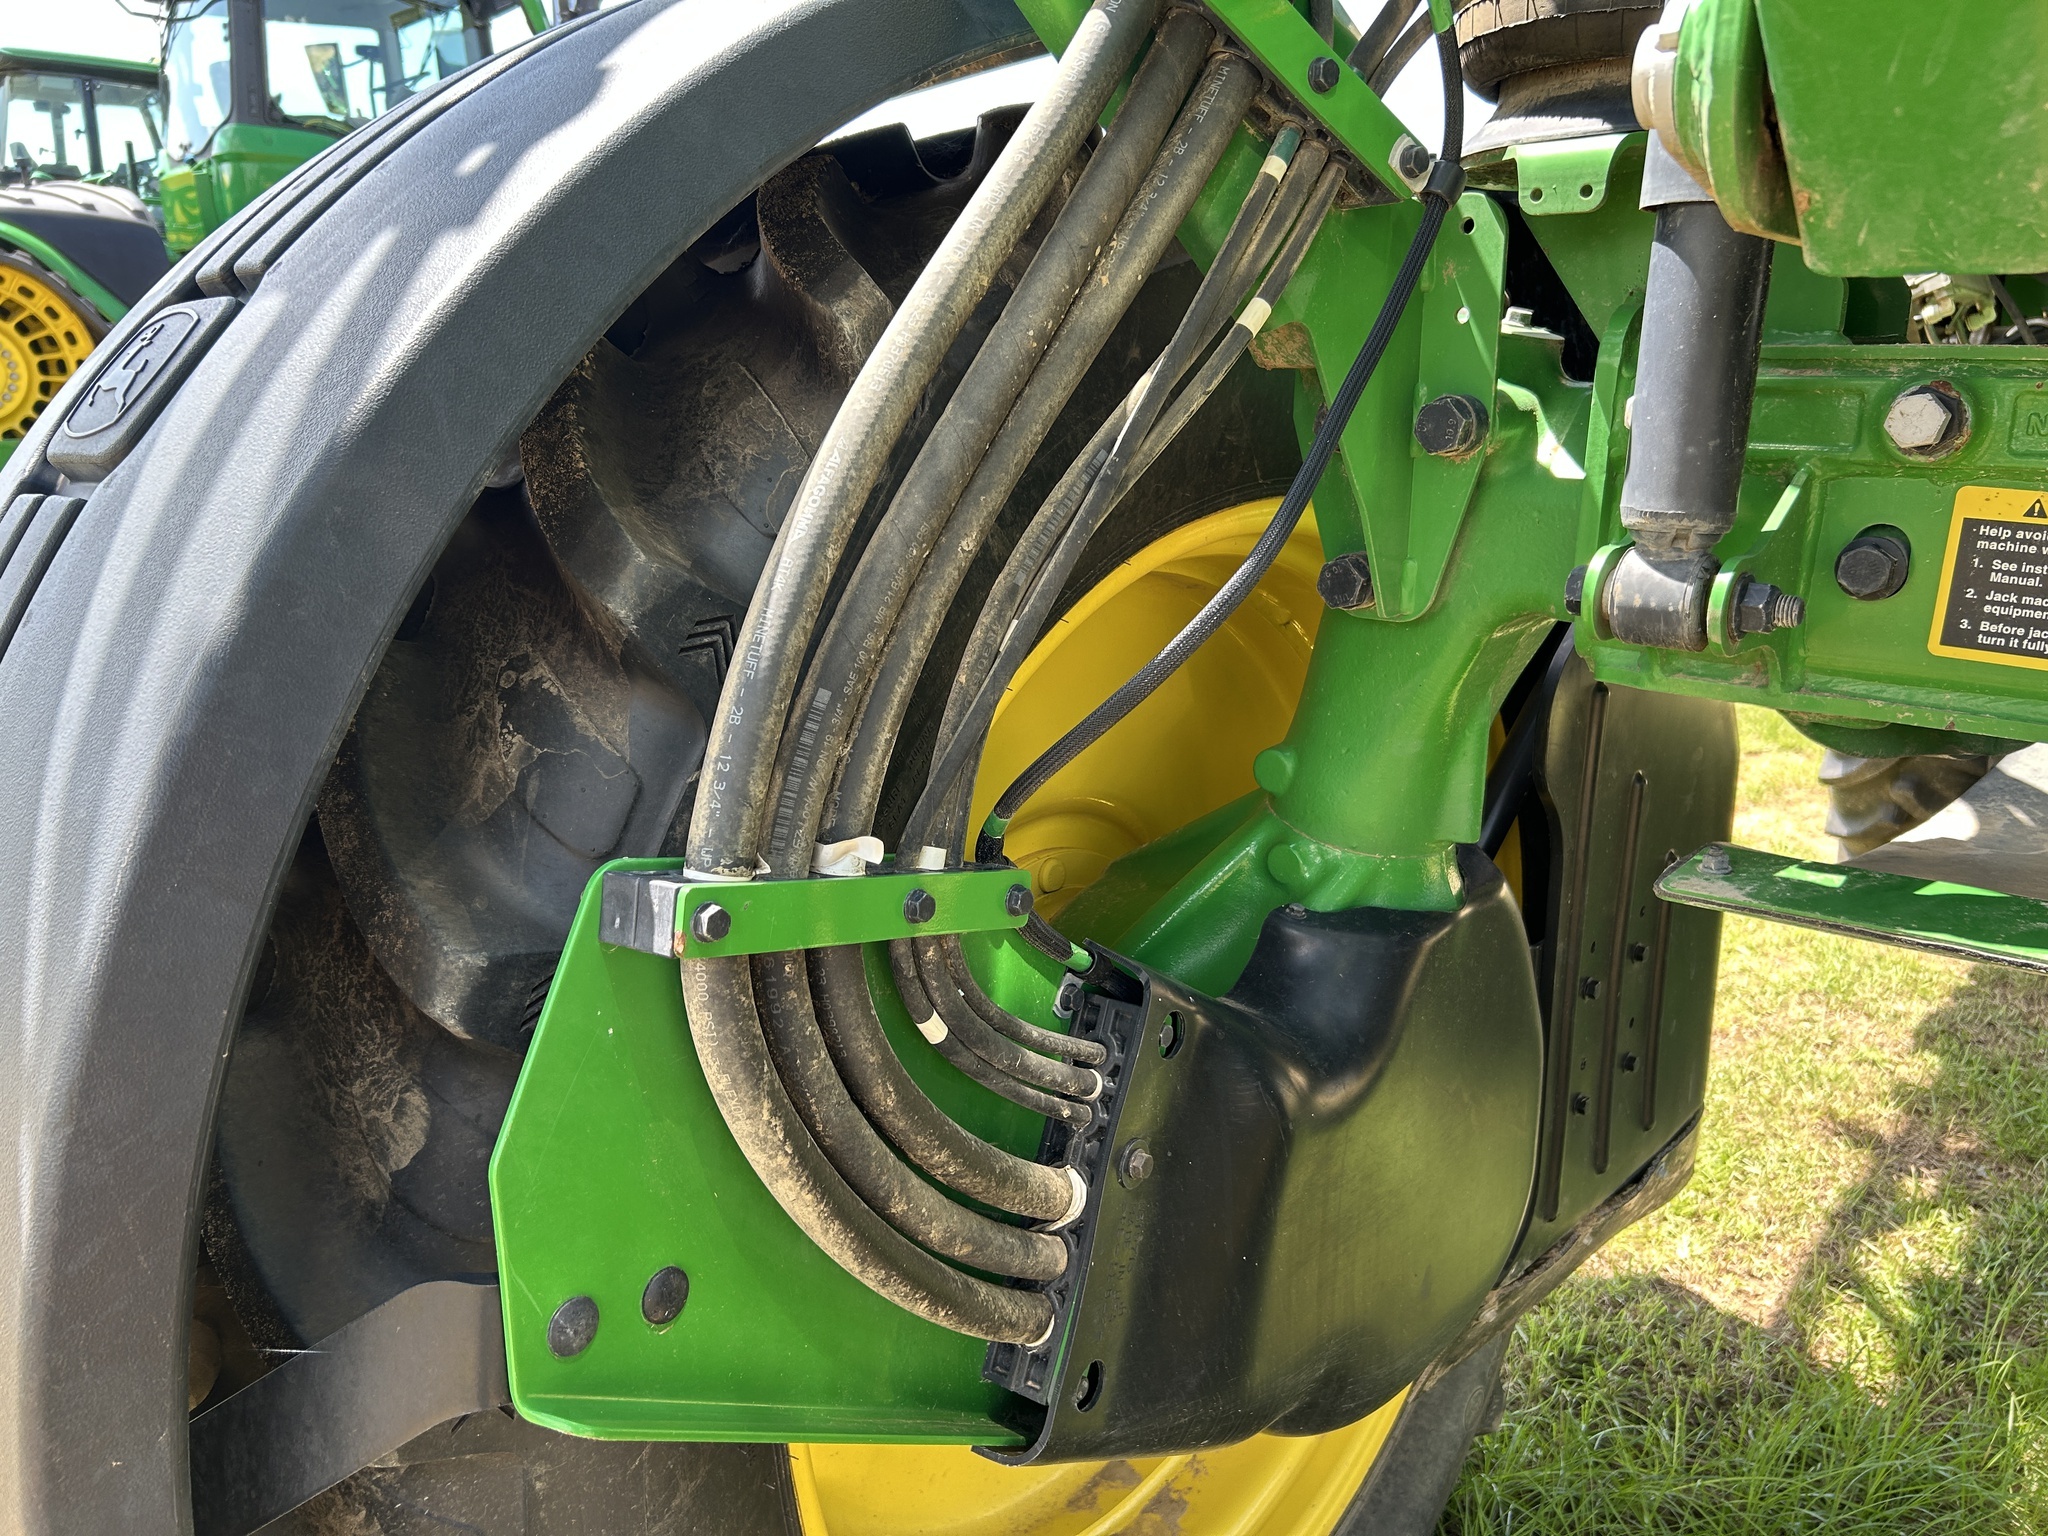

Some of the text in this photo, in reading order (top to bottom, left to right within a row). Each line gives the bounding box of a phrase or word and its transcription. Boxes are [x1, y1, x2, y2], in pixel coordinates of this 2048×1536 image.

[1195, 65, 1231, 124] MINETUFF
[1173, 140, 1188, 156] 2B
[983, 181, 1008, 212] MADE
[970, 217, 988, 233] IN
[1445, 418, 1458, 440] 10.9
[790, 448, 841, 544] ALFAGOMMA
[1979, 524, 2048, 541] Help avoi
[1976, 540, 2037, 554] machine
[1972, 558, 1983, 568] 1.
[1991, 559, 2018, 571] See
[1989, 572, 2043, 587] Manual.
[1965, 588, 1978, 599] 2.
[1985, 590, 2018, 603] Jack
[1959, 618, 1971, 629] 3.
[1980, 621, 2025, 636] Before
[743, 607, 774, 680] MINETUFF
[1977, 633, 2005, 646] turn
[2009, 637, 2019, 648] it
[825, 734, 835, 748] 19
[831, 703, 845, 726] 3/4"
[843, 672, 859, 696] SAE
[853, 650, 868, 669] 100
[863, 634, 876, 650] R6
[874, 606, 886, 625] WP
[729, 705, 743, 726] 2B
[717, 754, 732, 772] 12
[709, 780, 726, 817] 3/4"
[700, 847, 714, 867] WP
